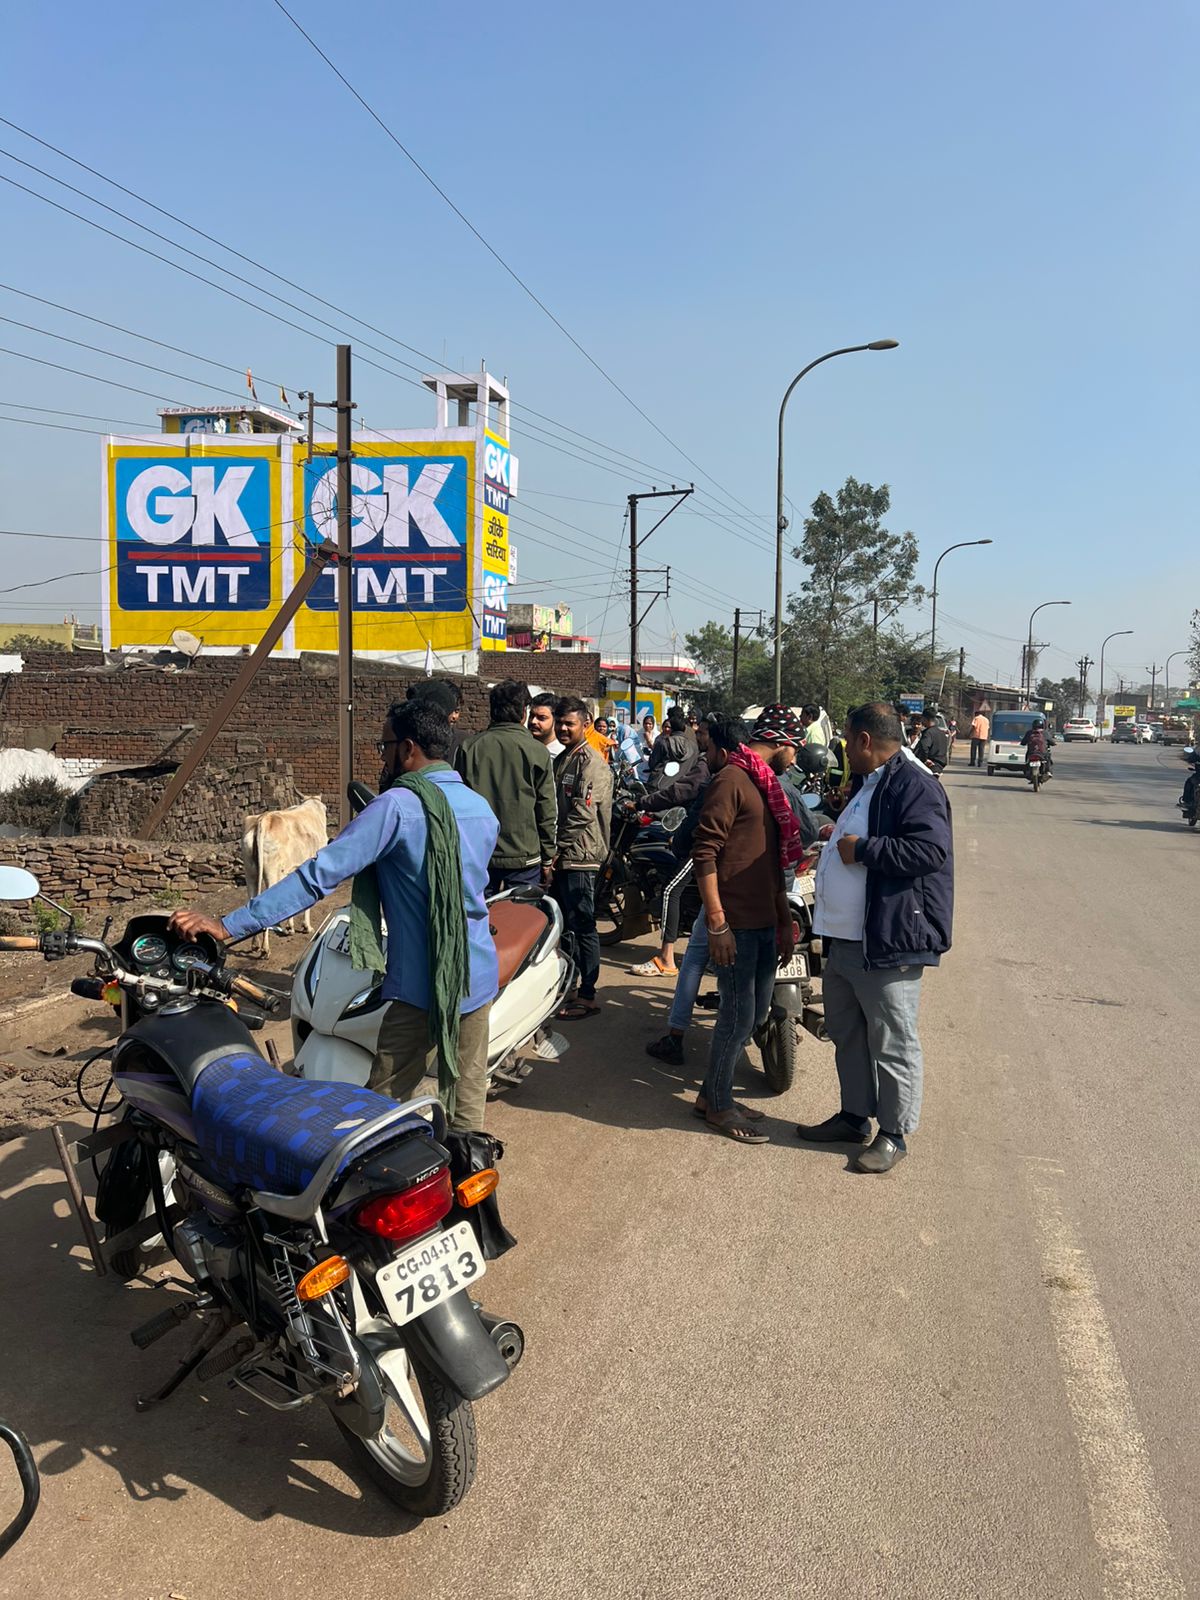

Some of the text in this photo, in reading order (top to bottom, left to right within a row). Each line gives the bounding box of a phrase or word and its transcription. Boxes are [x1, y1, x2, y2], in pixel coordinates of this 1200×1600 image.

[485, 442, 509, 488] GK
[126, 464, 260, 547] GK
[311, 462, 462, 548] GK
[486, 485, 508, 511] TMT
[486, 539, 507, 562] सरिया
[136, 566, 250, 604] TMT
[321, 567, 448, 604] TMT
[484, 575, 508, 612] GK
[484, 616, 507, 637] TMT
[396, 1232, 460, 1281] CG-04-FJ
[395, 1251, 478, 1316] 7813
